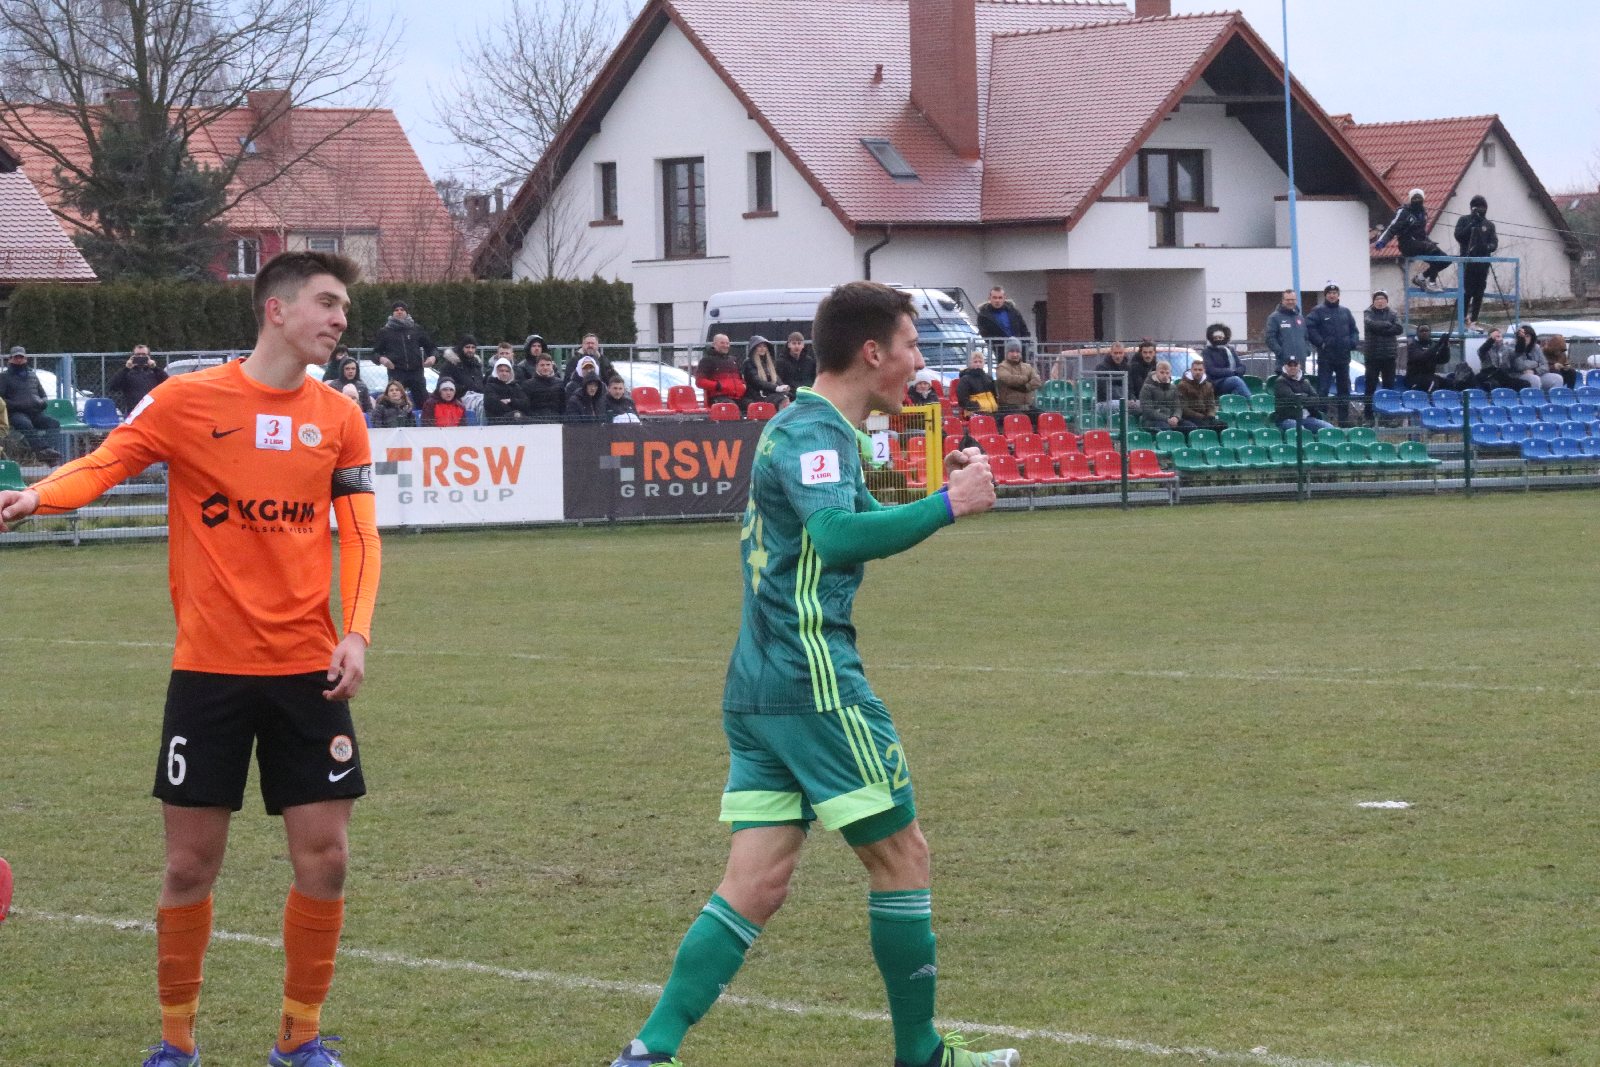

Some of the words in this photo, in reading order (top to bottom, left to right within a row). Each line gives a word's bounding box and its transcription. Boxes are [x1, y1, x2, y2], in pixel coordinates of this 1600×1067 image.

[1211, 297, 1222, 308] 25
[267, 419, 280, 437] 3
[877, 442, 885, 459] 2
[422, 446, 525, 487] RSW
[643, 440, 742, 480] RSW
[812, 454, 826, 473] 3
[398, 488, 514, 505] GROUP
[620, 481, 732, 498] GROUP
[237, 499, 315, 523] KGHM
[167, 735, 188, 786] 6
